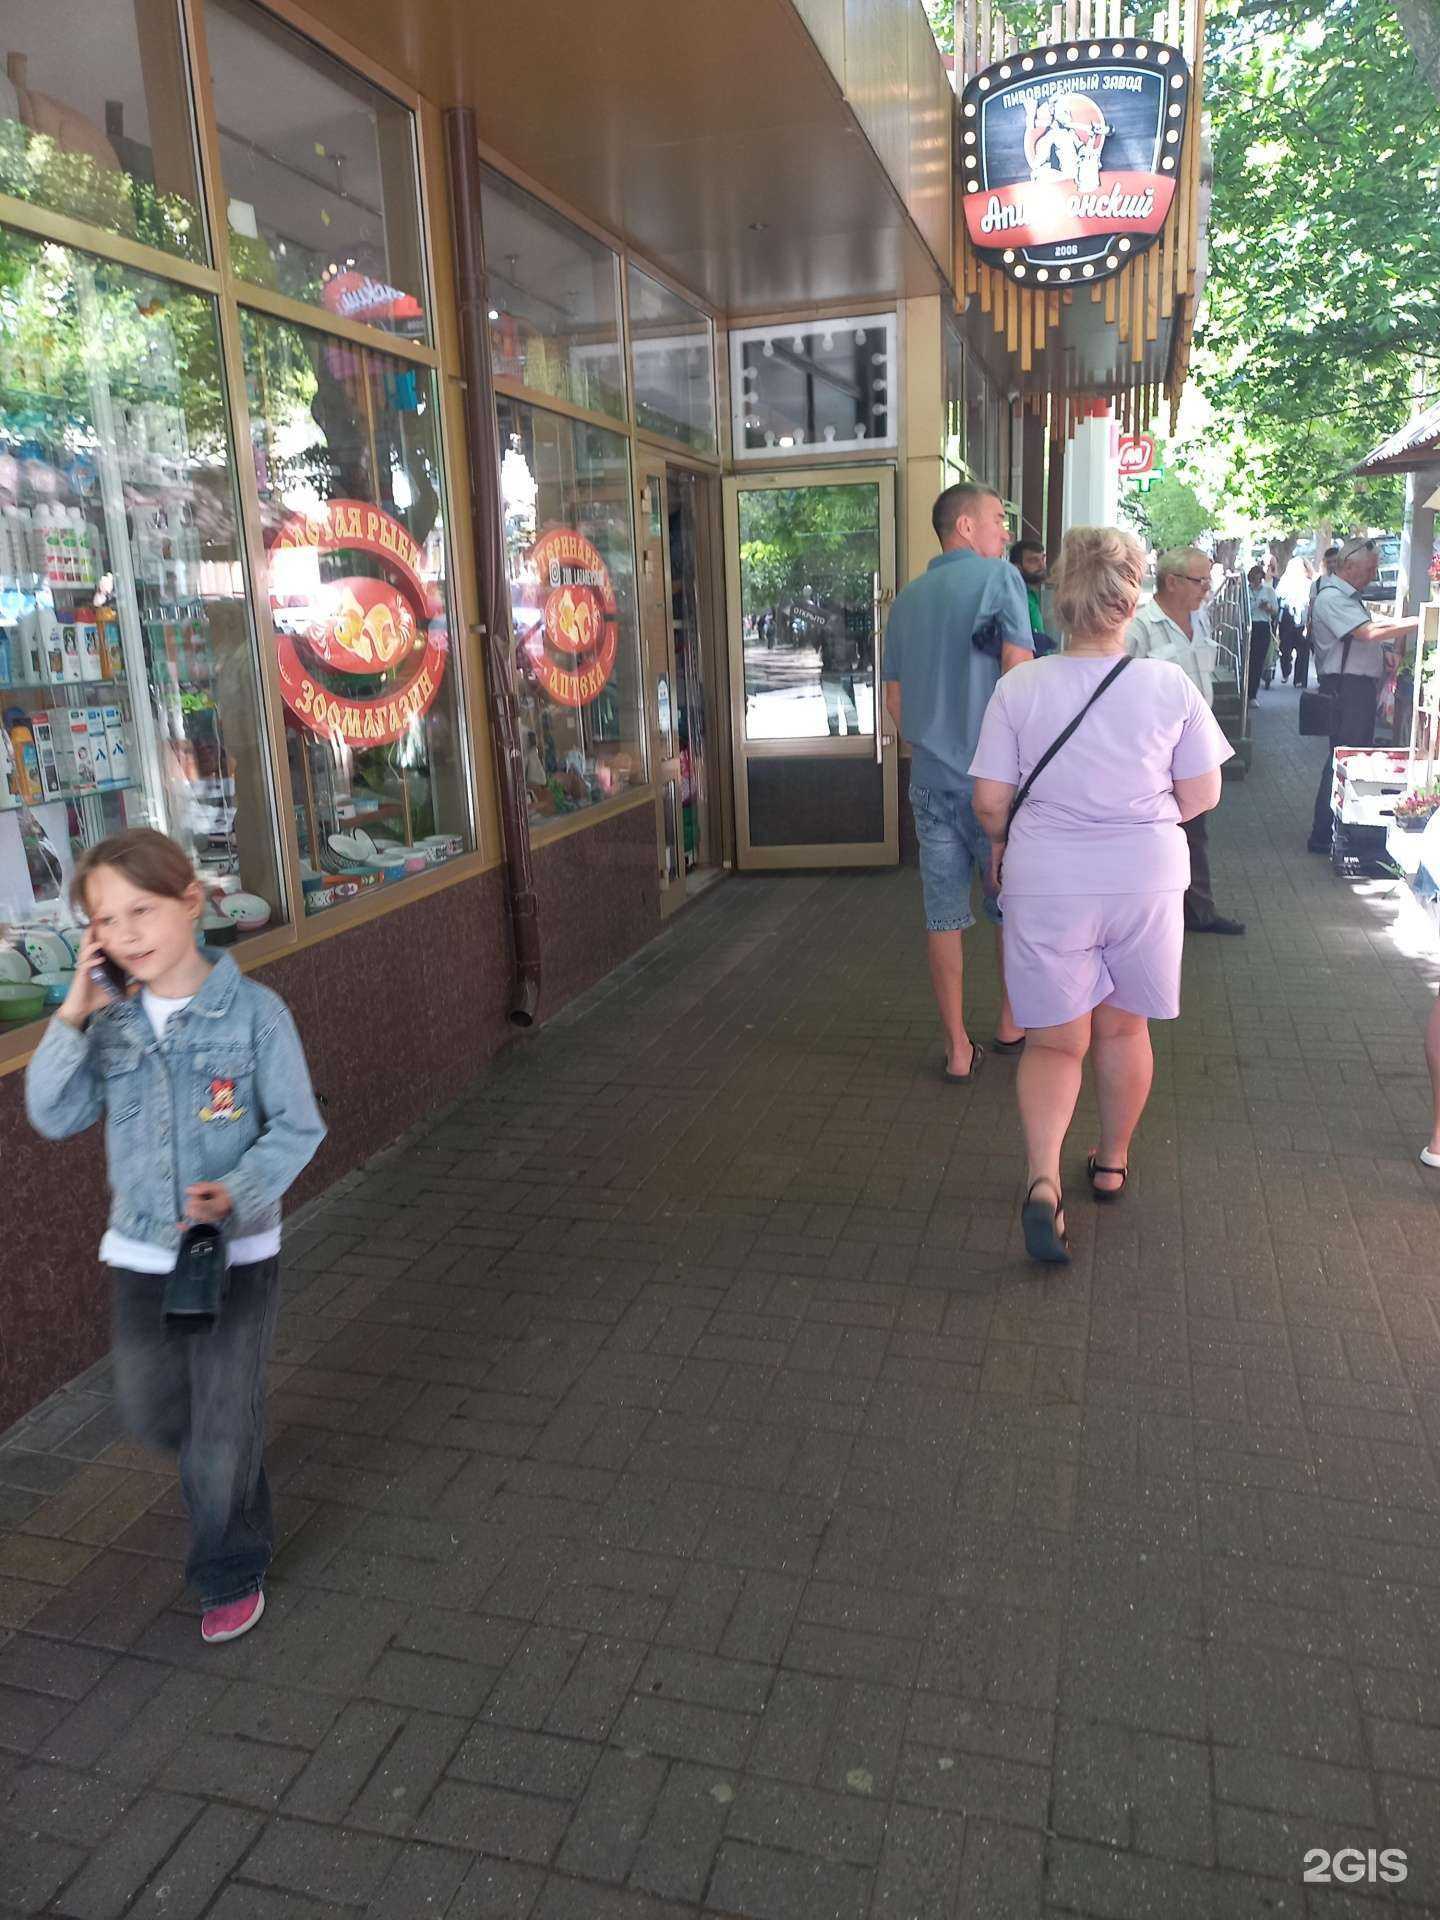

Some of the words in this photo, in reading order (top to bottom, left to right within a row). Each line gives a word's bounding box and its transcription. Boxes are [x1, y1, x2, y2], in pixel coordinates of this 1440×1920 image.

[1002, 74, 1100, 109] ПИВОВАРЕННЫЙ
[1101, 75, 1144, 93] ЗАВОД
[549, 661, 606, 701] АПТЕКА
[295, 667, 434, 739] ЗООМАГАЗИН
